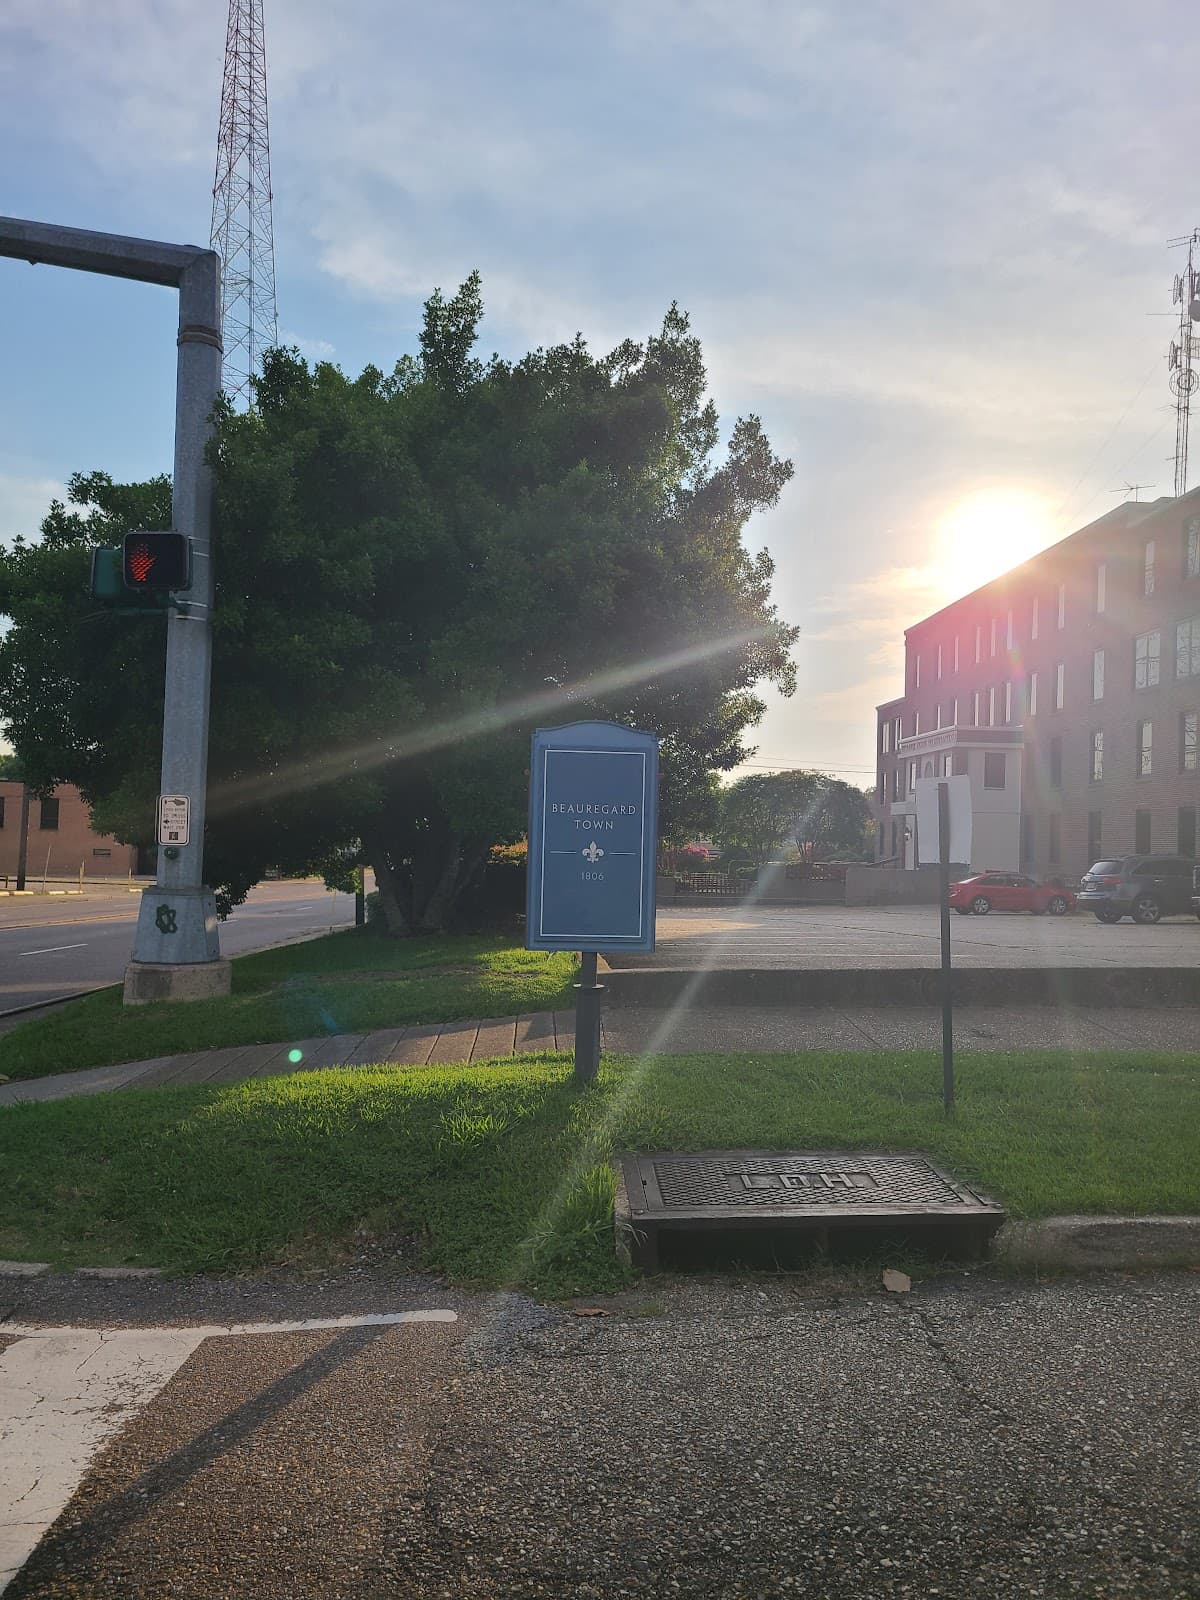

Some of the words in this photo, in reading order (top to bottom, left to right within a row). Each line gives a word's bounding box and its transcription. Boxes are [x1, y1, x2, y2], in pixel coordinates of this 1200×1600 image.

[552, 803, 636, 815] BEAUREGARD
[575, 819, 614, 830] TOWN
[581, 871, 604, 881] 1806
